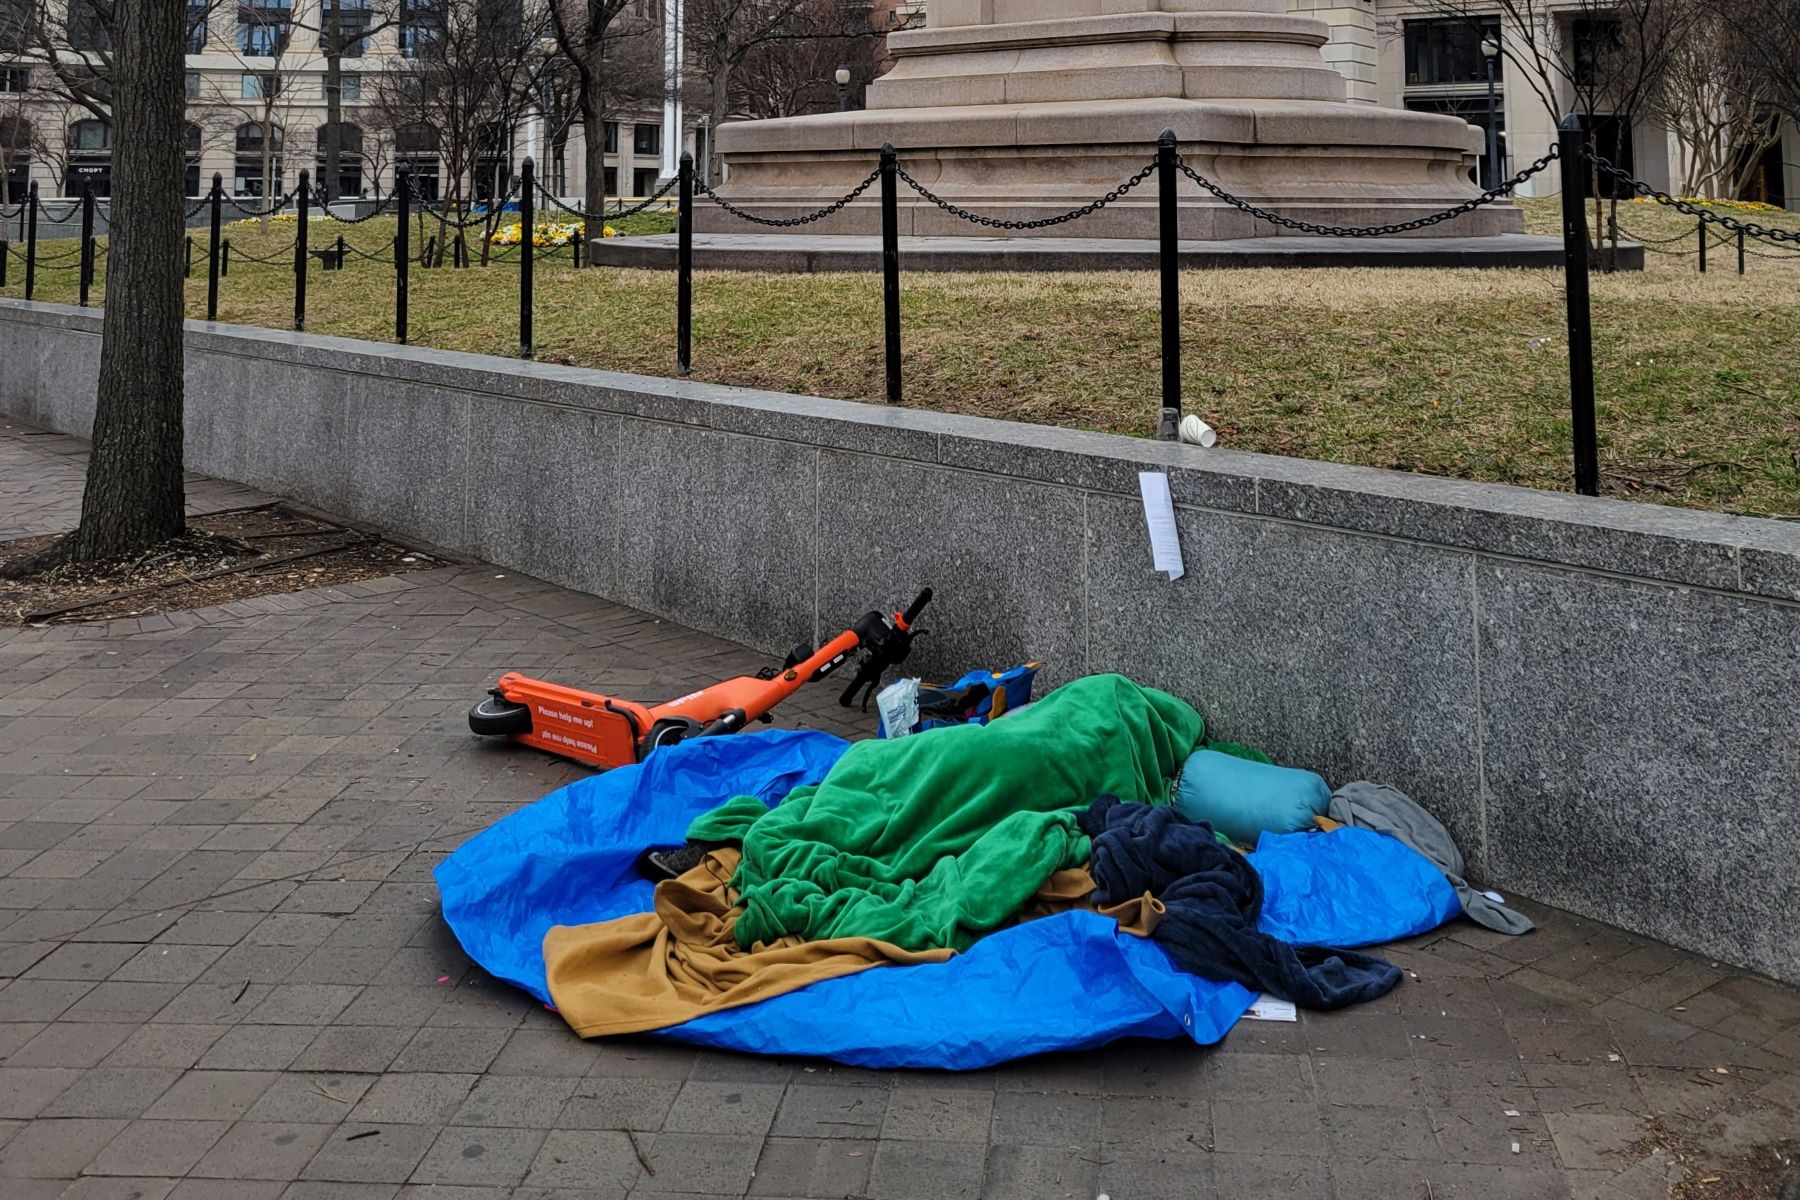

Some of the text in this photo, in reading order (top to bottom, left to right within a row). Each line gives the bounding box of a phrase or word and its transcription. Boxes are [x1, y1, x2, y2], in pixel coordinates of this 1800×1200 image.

[538, 706, 558, 718] Please
[559, 711, 572, 723] help
[573, 716, 583, 725] me
[552, 733, 562, 742] me
[562, 736, 576, 747] help
[576, 740, 598, 753] Please
